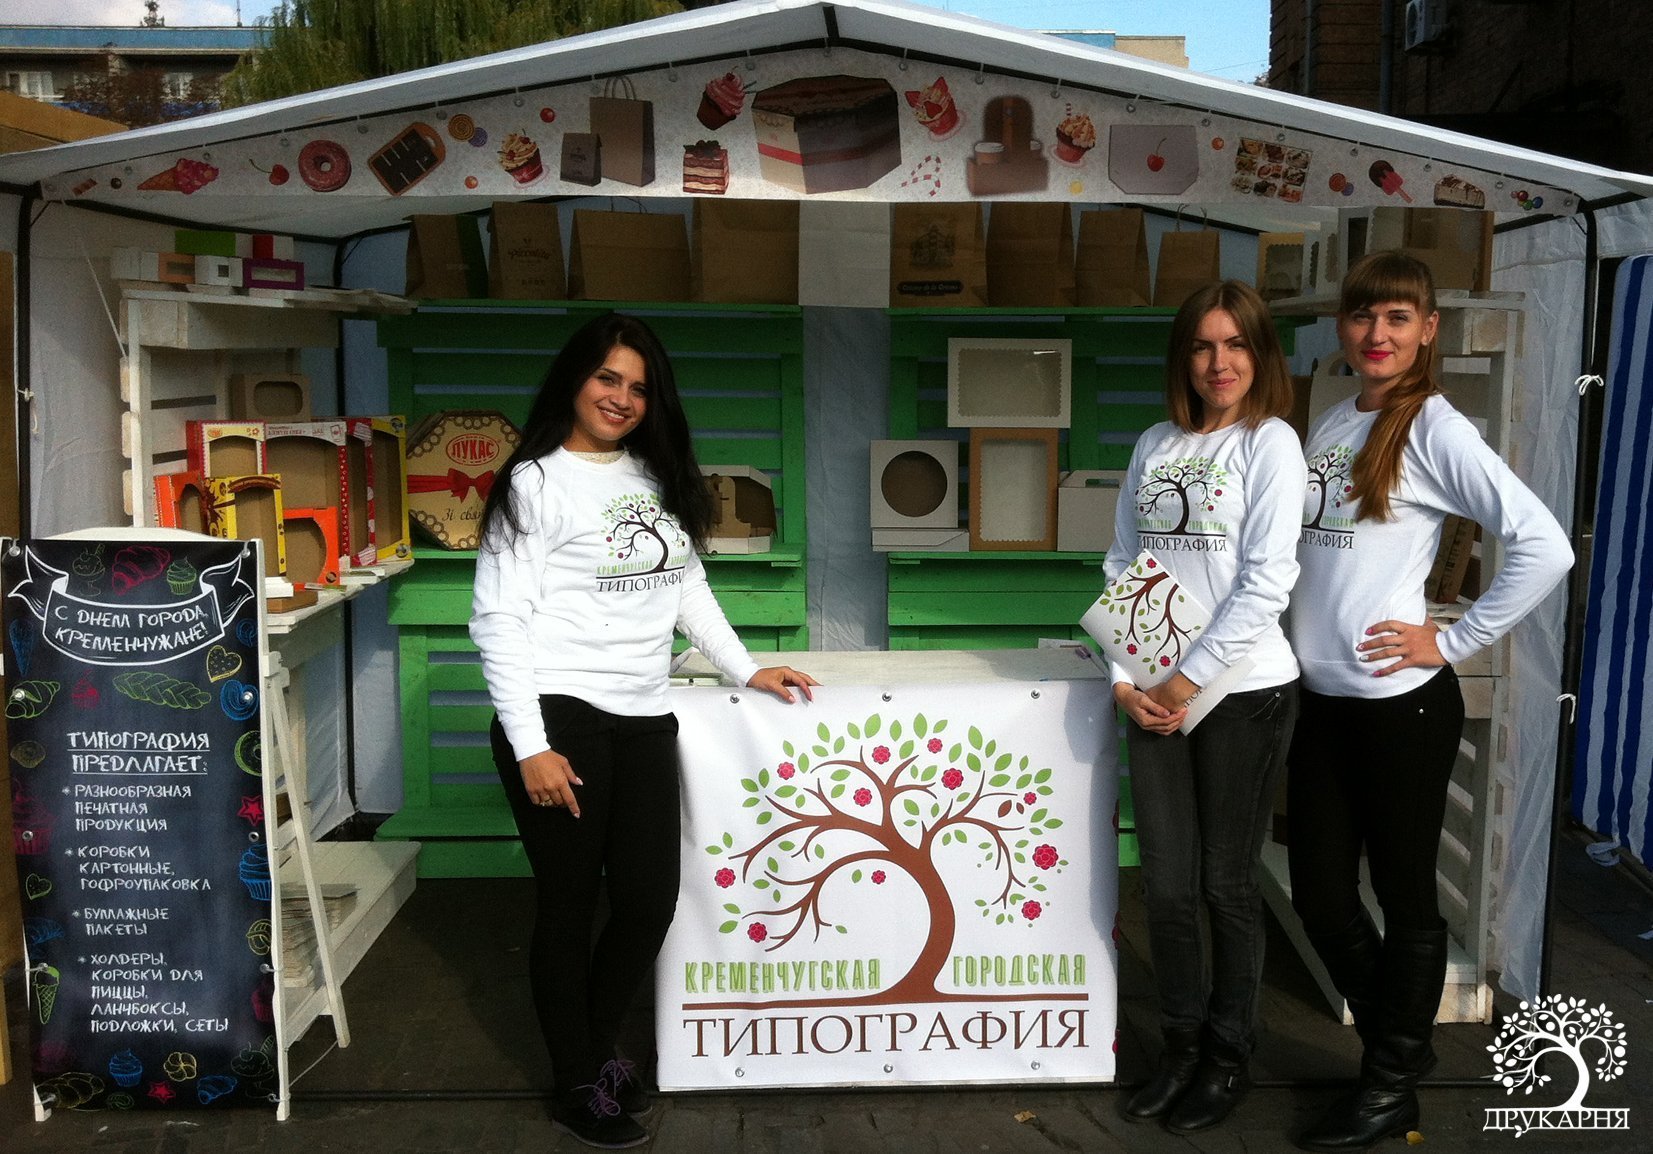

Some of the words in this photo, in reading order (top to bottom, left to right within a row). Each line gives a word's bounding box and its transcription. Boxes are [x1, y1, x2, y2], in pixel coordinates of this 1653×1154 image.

[452, 440, 494, 460] ЛУКАС
[460, 507, 481, 521] свя
[1299, 530, 1354, 549] ОГРАФИЯ
[597, 572, 684, 592] ТИПОГРАФИ
[55, 605, 68, 620] С
[77, 609, 131, 628] ДНЕМ
[55, 621, 209, 652] КРЕМЕНЧУЖАНЕ!
[66, 731, 210, 751] ТИПОГРАФИЯ
[72, 754, 208, 773] ПРЕДЛАГАЕТ:
[74, 784, 192, 799] РАЗНООБРАЗНАЯ
[75, 801, 149, 815] ПЕЧАТНАЯ
[75, 818, 168, 833] ПРОДУКЦИЯ
[78, 845, 151, 858] КОРОБКИ
[79, 862, 175, 876] КАРТОННЫЕ,
[80, 878, 211, 891] ГОФРОУПАКОВКА
[84, 907, 169, 920] БУМАЖНЫЕ
[86, 923, 148, 936] ПАКЕТЫ
[91, 969, 163, 982] КОРОБКИ
[170, 969, 204, 982] ДЛЯ
[684, 958, 882, 994] КРЕМЕНЧУГСКАЯ
[952, 954, 1087, 988] ГОРОДСКАЯ
[90, 1002, 190, 1016] ЛАНЧБОКСЫ,
[185, 1018, 229, 1033] СЕТЫ
[682, 1009, 1090, 1058] ТИПОГРАФИЯ
